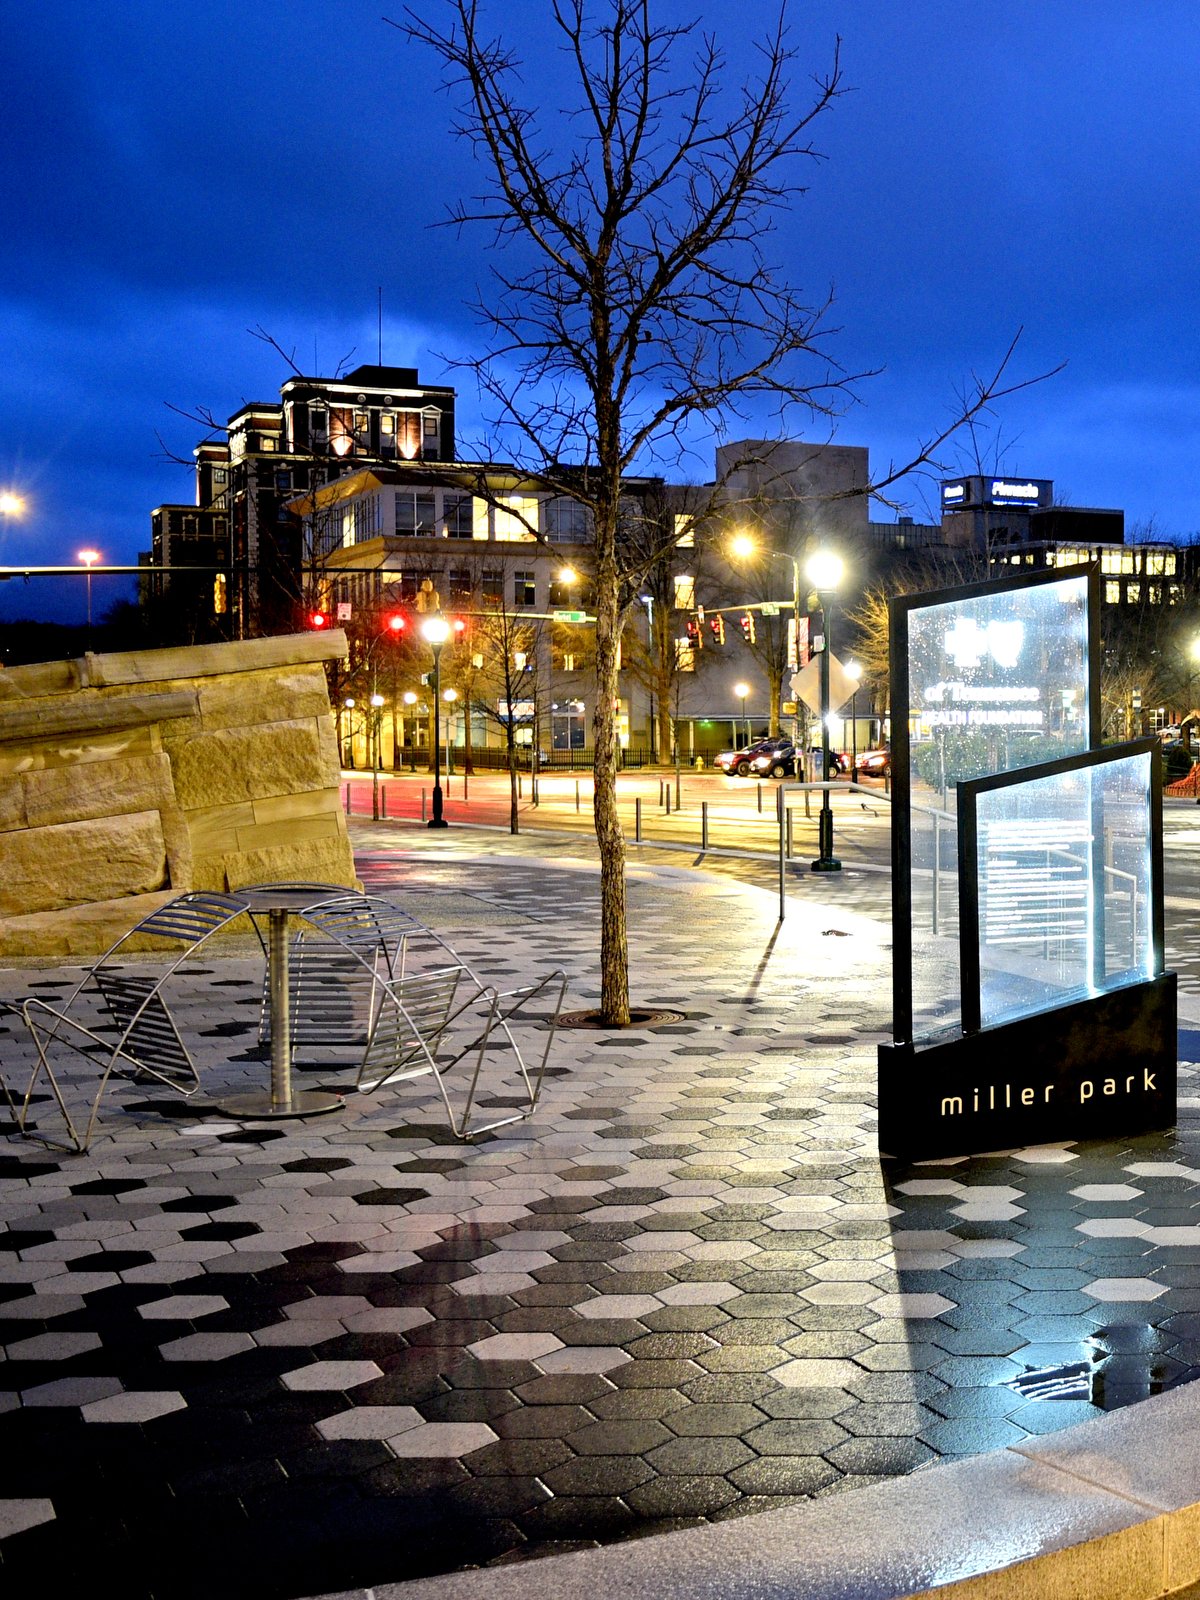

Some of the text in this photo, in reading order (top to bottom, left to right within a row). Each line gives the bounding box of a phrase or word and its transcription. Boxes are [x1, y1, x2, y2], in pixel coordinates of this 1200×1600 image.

[921, 710, 1043, 725] HEALTH FOUNDATION
[941, 1068, 1157, 1116] miller park
